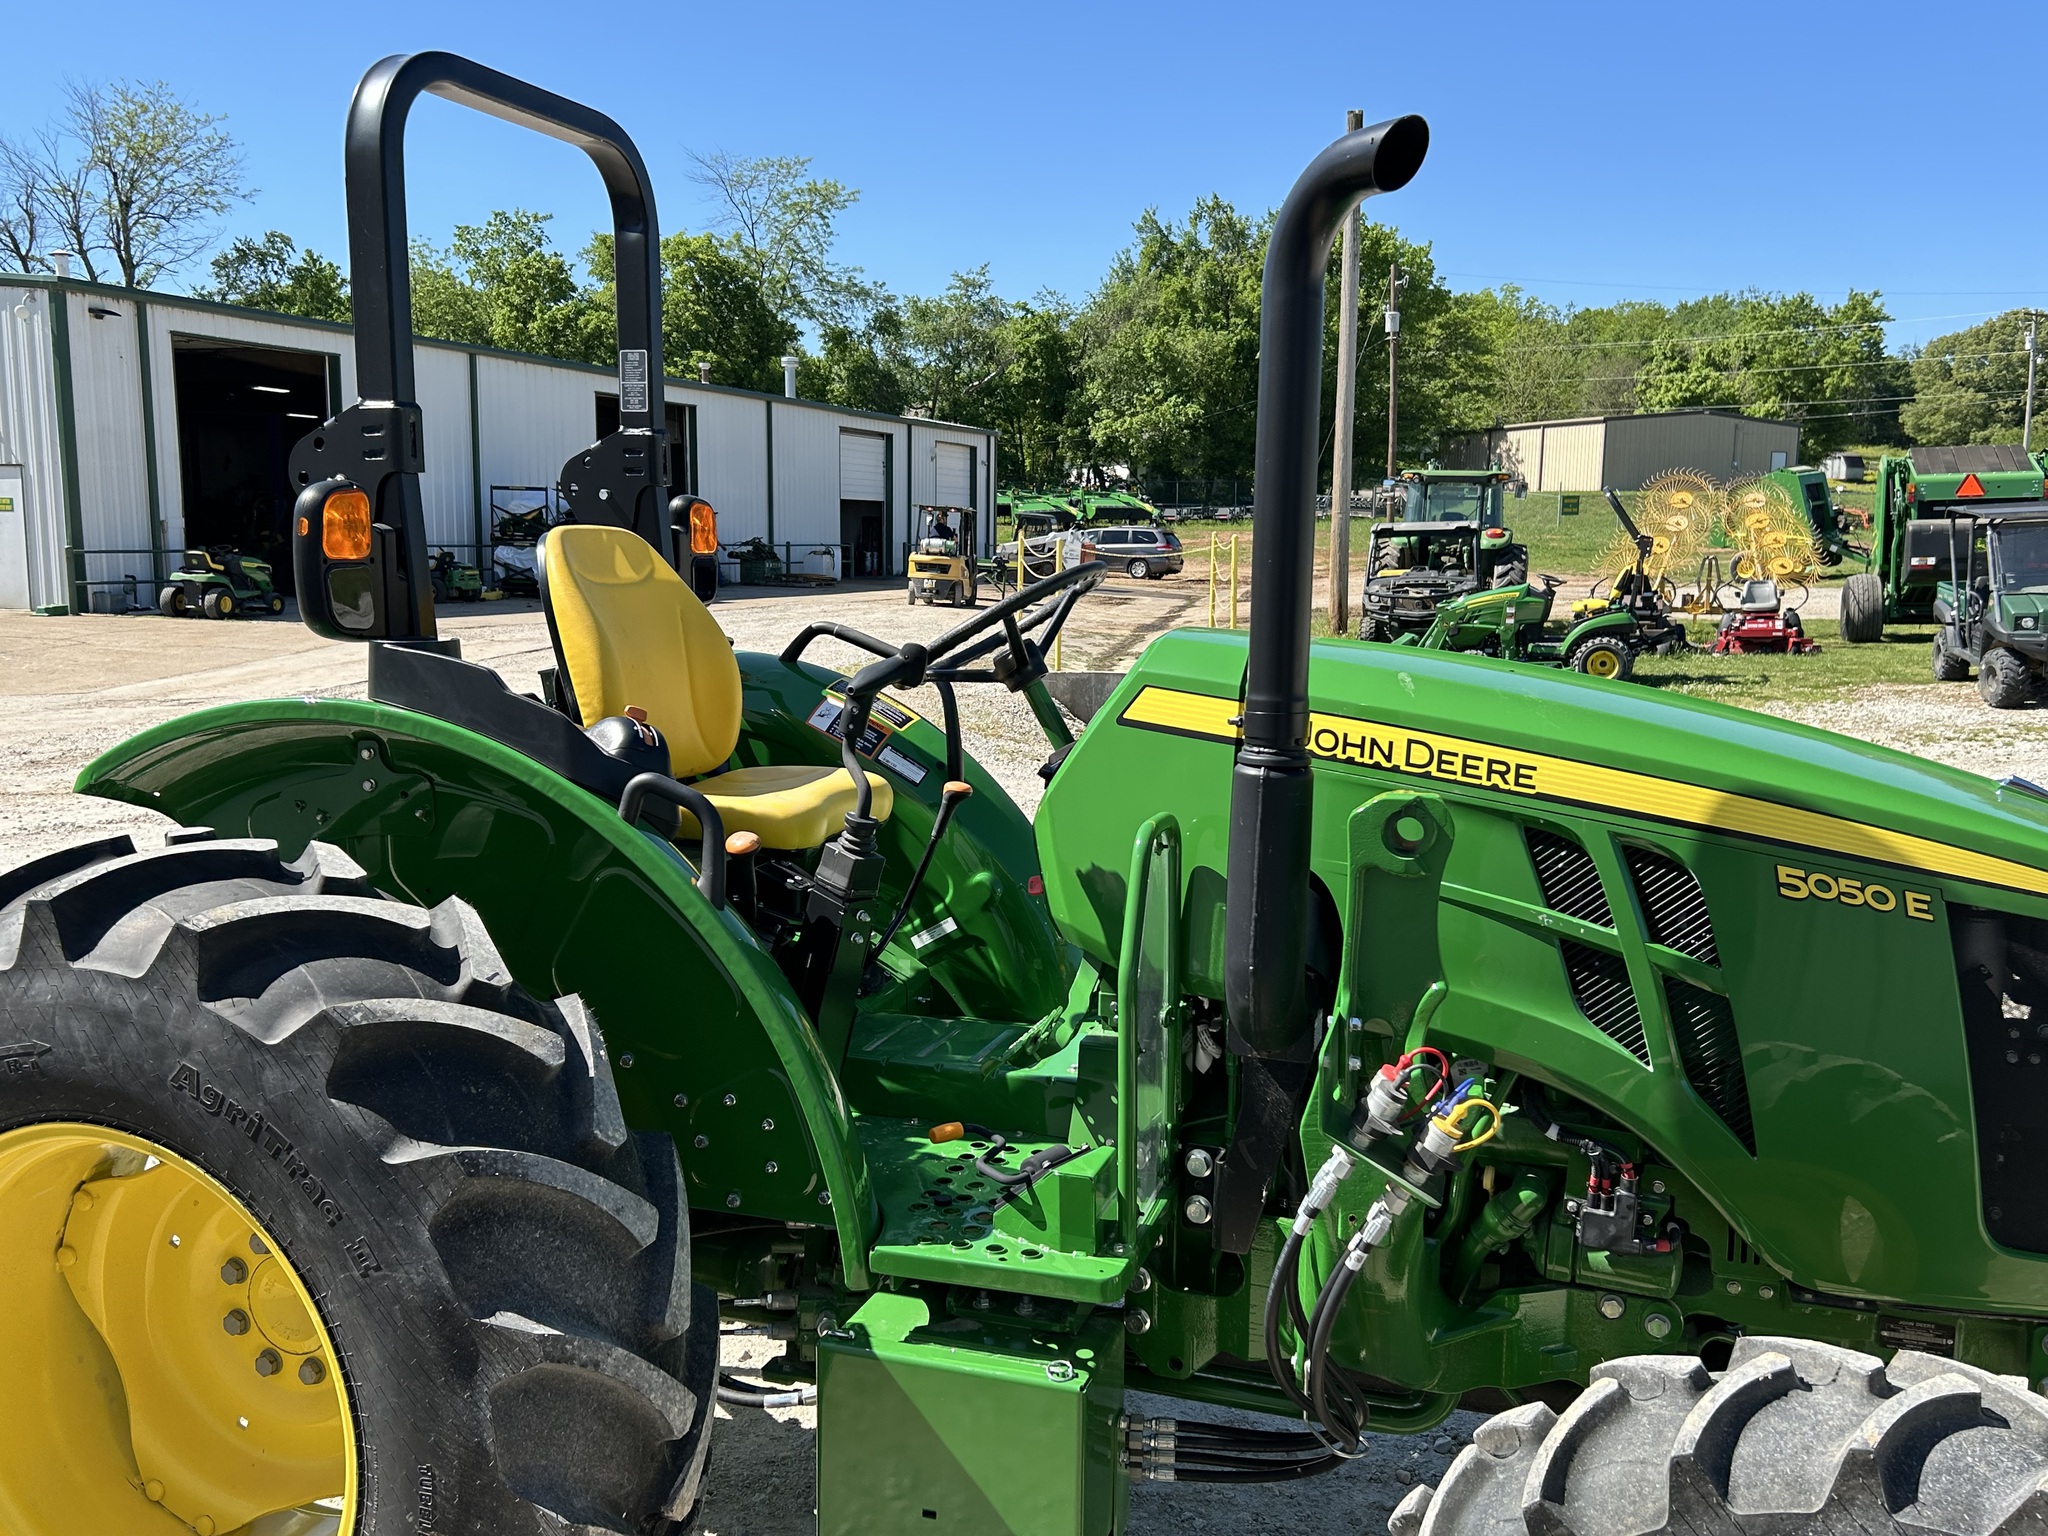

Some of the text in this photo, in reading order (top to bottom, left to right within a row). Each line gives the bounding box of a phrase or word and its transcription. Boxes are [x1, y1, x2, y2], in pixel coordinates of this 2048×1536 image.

[924, 579, 936, 588] CAT
[1404, 738, 1538, 790] DEERE
[1776, 864, 1935, 922] 5050 E
[168, 1062, 344, 1228] AgriTrac
